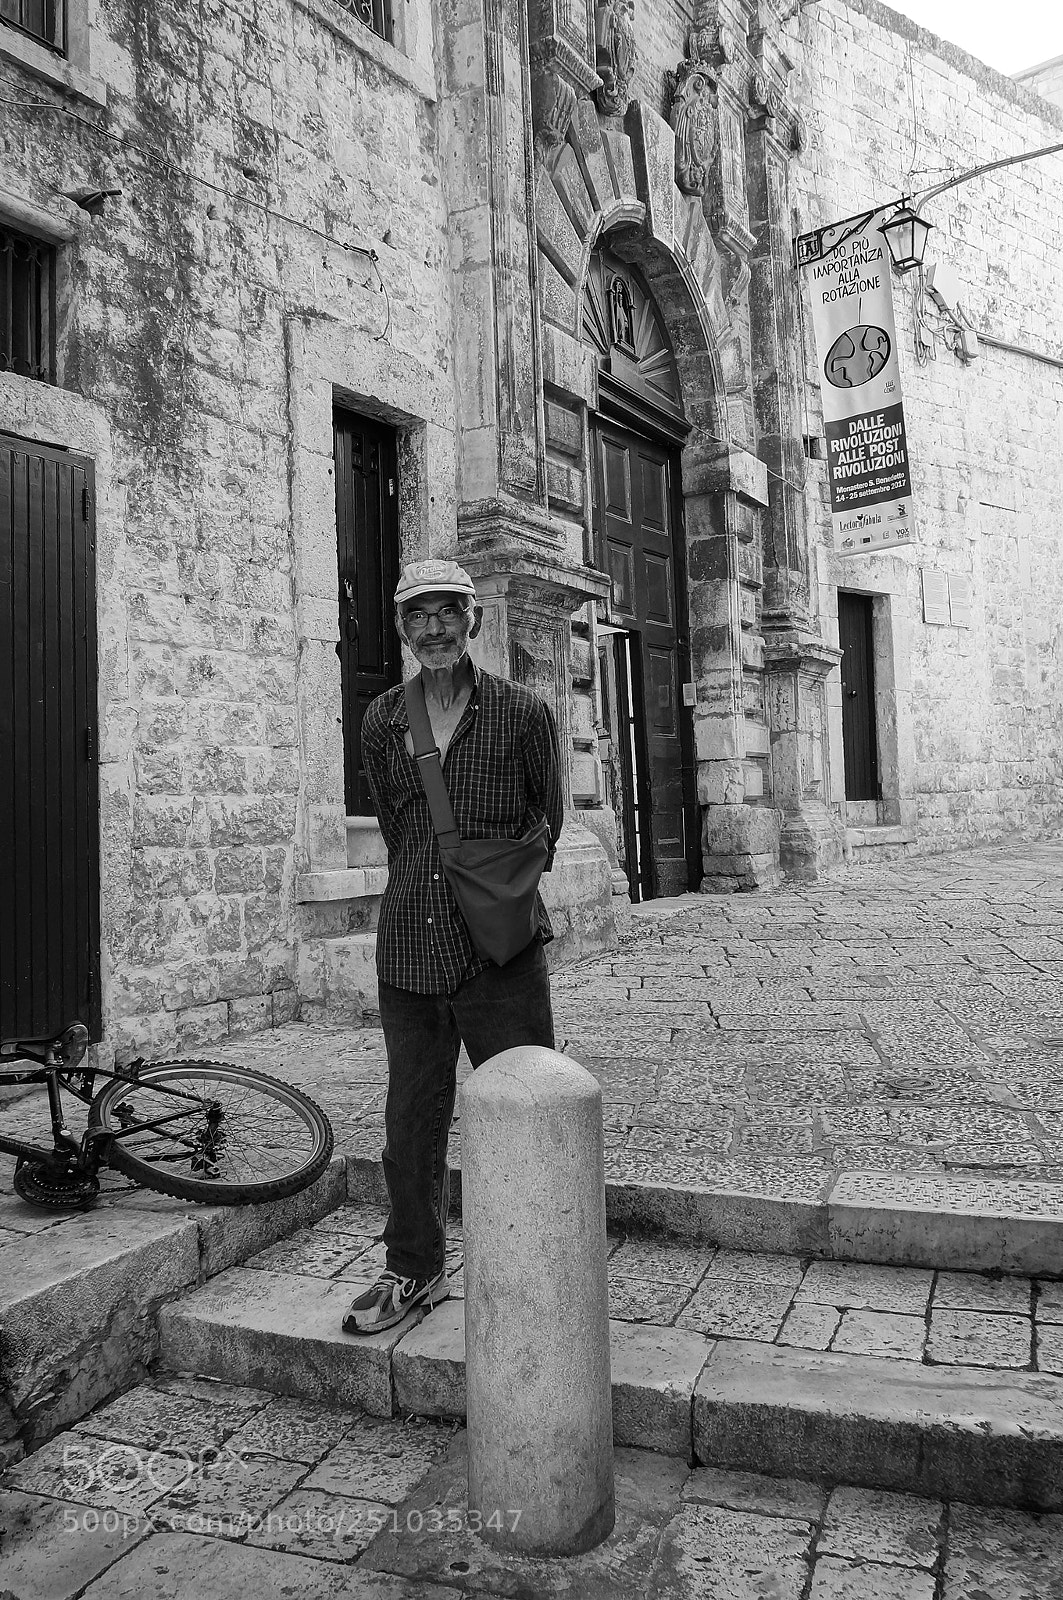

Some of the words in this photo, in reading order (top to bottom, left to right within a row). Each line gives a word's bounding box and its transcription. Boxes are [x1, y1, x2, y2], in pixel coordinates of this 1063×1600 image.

[852, 236, 870, 254] PIÙ
[813, 247, 884, 280] IMPORTANZA
[838, 268, 860, 285] ALLA
[822, 275, 881, 305] ROTAZIONE
[848, 413, 886, 435] DALLE
[830, 422, 903, 453] RIVOLUZIONI
[832, 449, 905, 480] RIVOLUZIONI
[837, 446, 867, 466] ALLE
[869, 438, 899, 458] POST
[836, 481, 869, 494] Monastero
[875, 472, 905, 485] Benedetto
[890, 479, 907, 490] 2017
